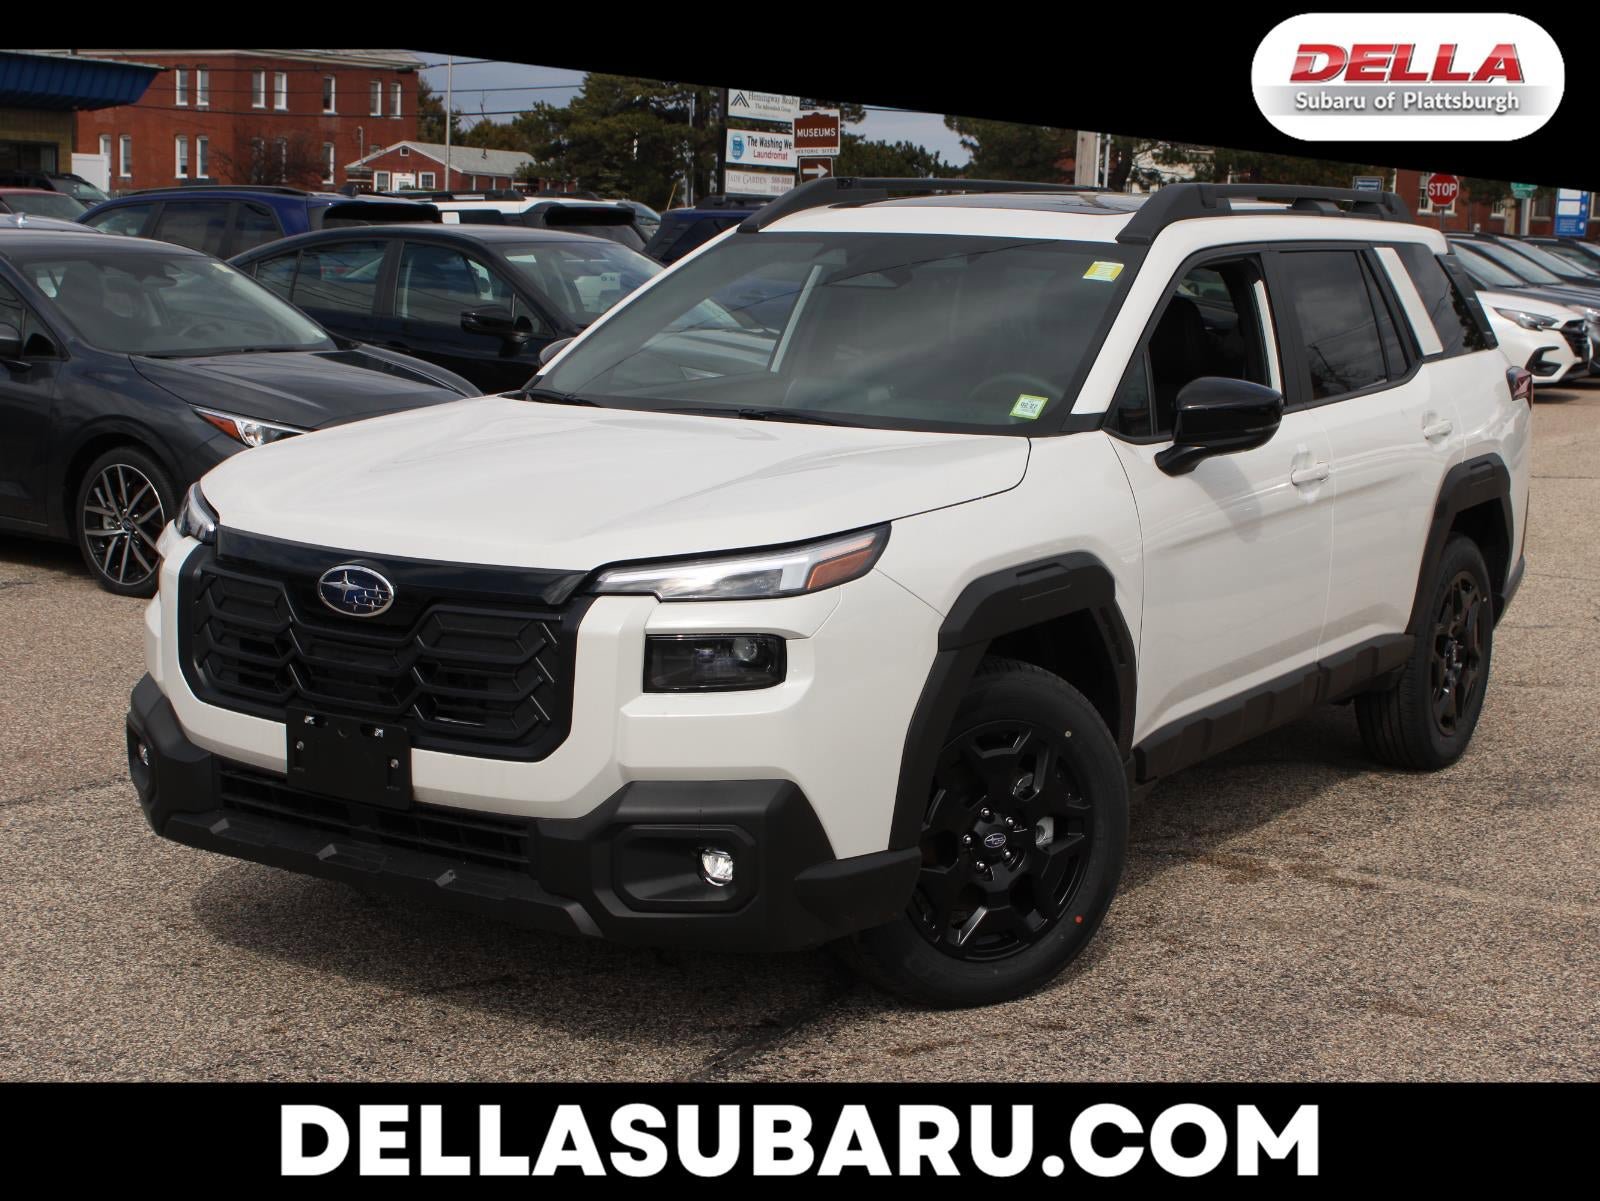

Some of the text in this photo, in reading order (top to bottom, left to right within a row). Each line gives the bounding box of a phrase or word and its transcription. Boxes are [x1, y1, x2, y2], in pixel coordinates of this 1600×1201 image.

[797, 128, 836, 138] MUSEUMS
[747, 135, 758, 147] The
[759, 137, 783, 151] Washing
[753, 150, 788, 161] Laundromat
[1428, 182, 1457, 197] STOP
